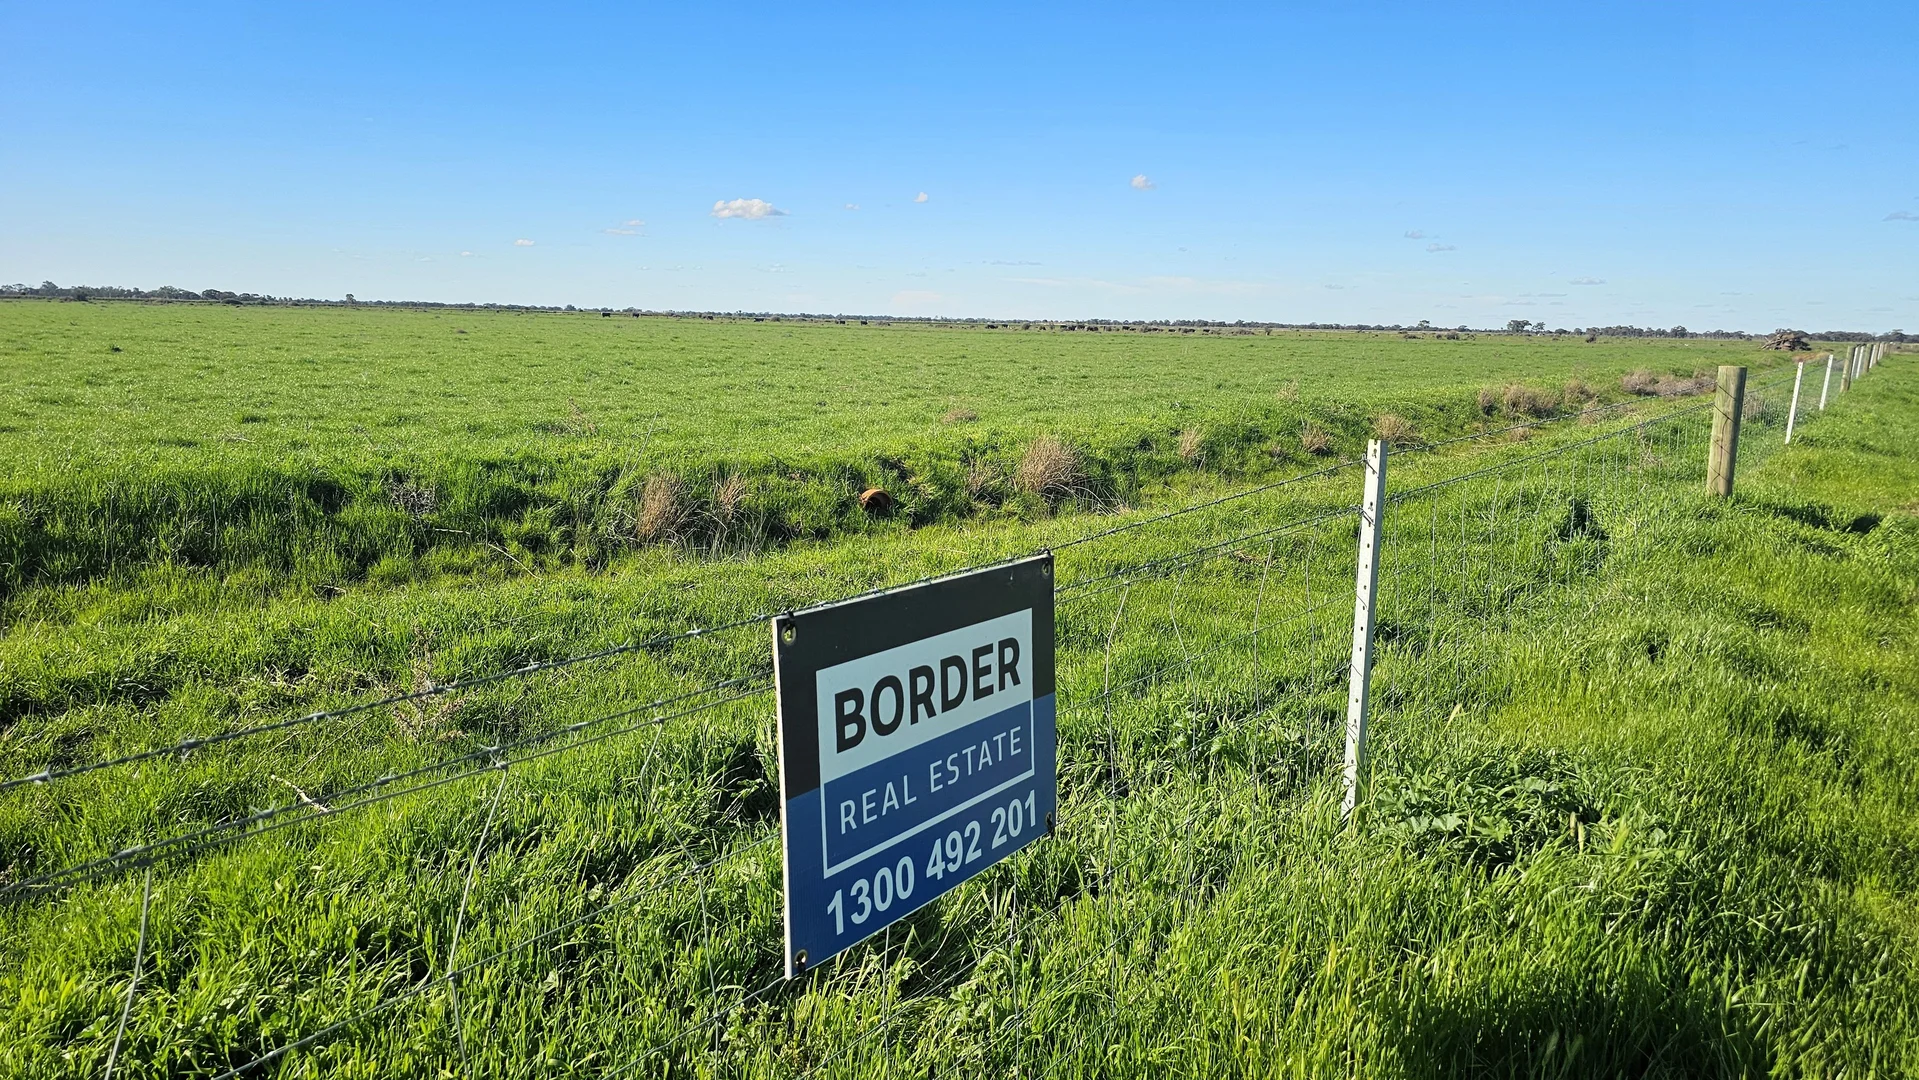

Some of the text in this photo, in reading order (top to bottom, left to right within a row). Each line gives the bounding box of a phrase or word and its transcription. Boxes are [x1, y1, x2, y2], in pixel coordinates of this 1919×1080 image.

[834, 637, 1021, 754] BORDER
[840, 726, 1022, 835] REAL ESTATE
[827, 789, 1037, 935] 1300 492 201
